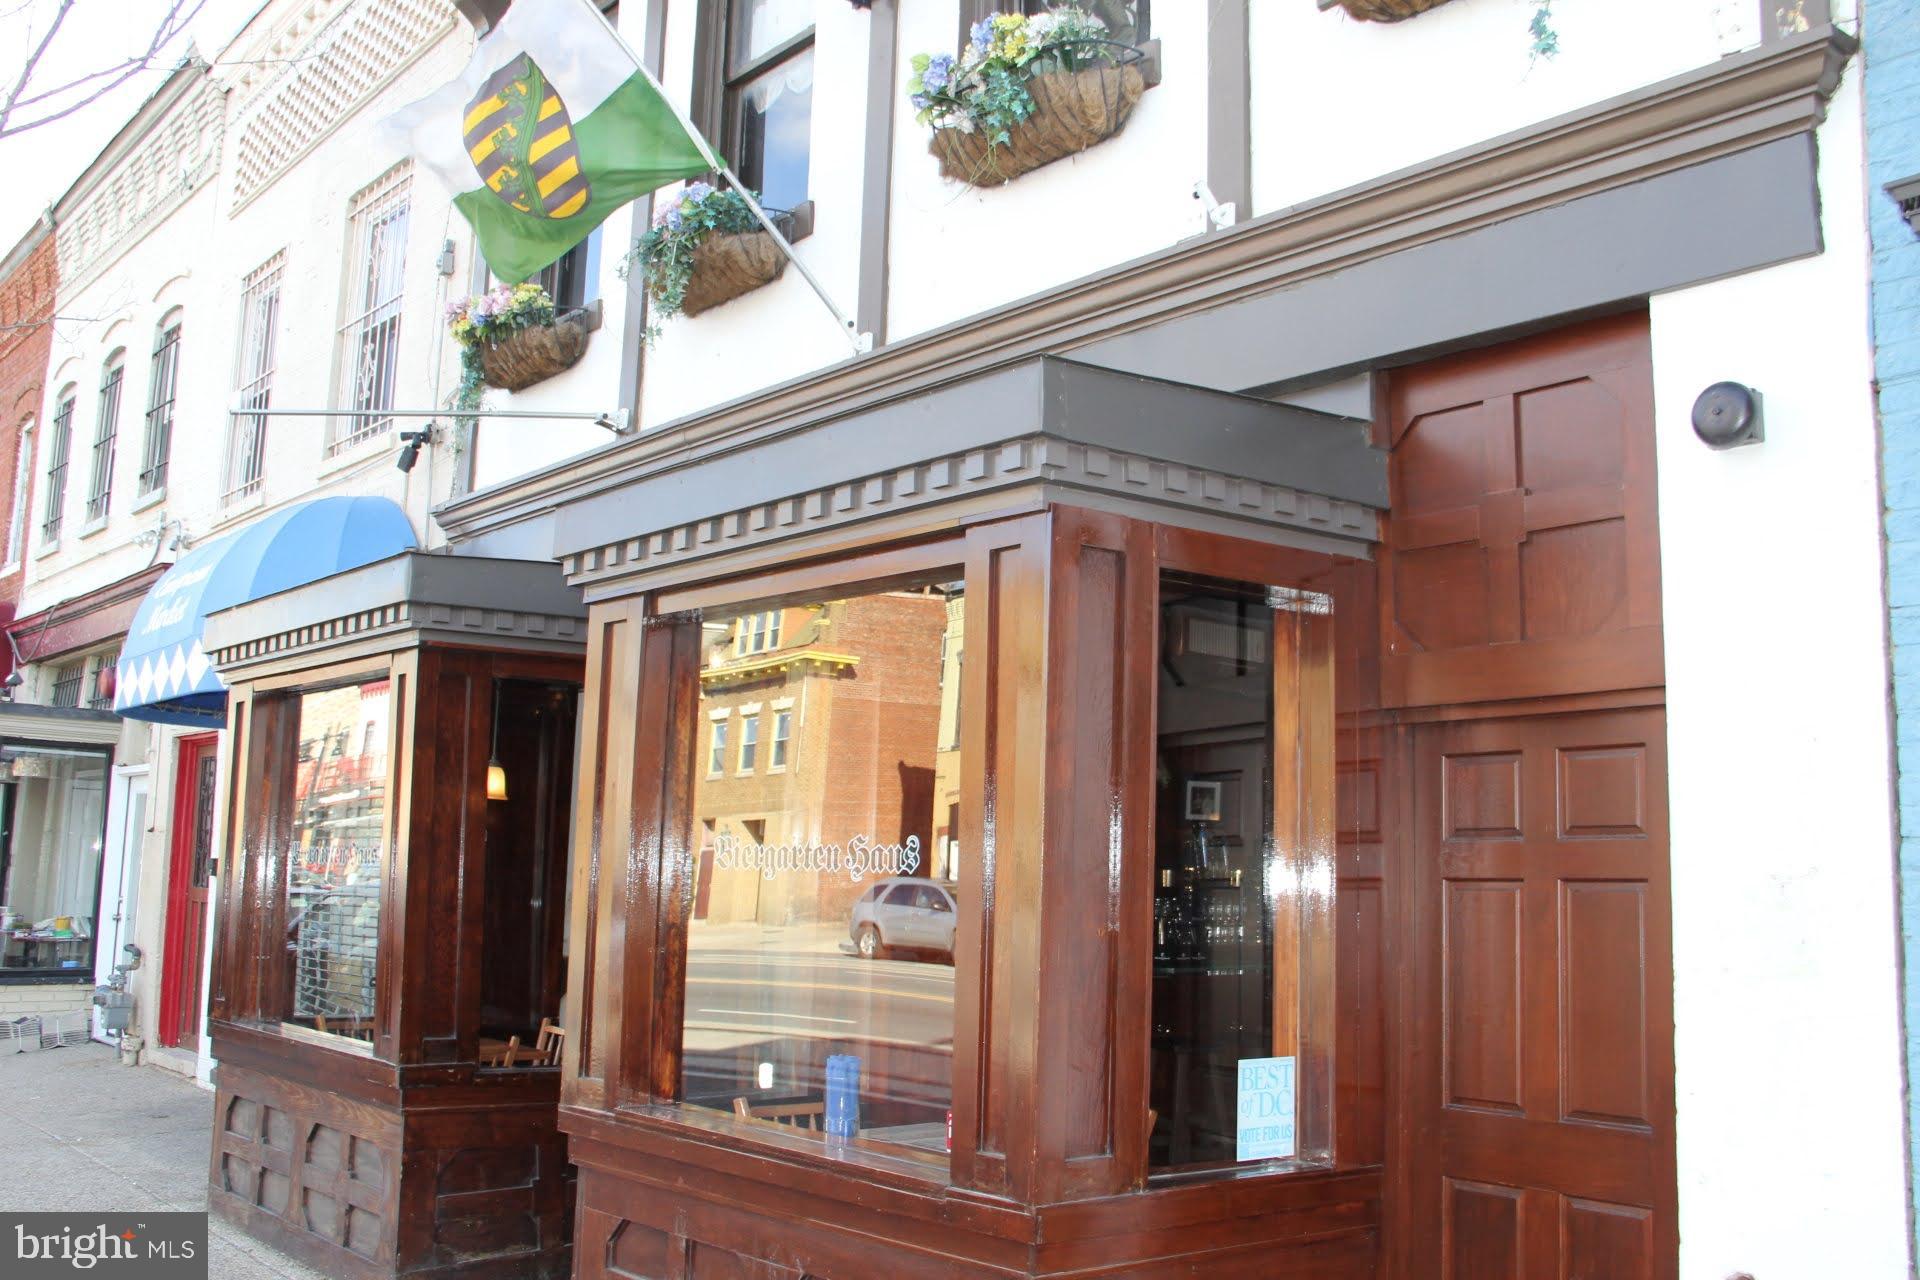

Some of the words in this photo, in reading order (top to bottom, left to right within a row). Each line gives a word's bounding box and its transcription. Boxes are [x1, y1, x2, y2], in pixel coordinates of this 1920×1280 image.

[713, 834, 841, 880] Biergarten
[845, 833, 920, 882] Haus
[1240, 1064, 1293, 1091] BEST
[1240, 1095, 1254, 1118] of
[1239, 1127, 1261, 1143] VOTE
[1262, 1126, 1279, 1141] FOR
[1280, 1124, 1293, 1139] US
